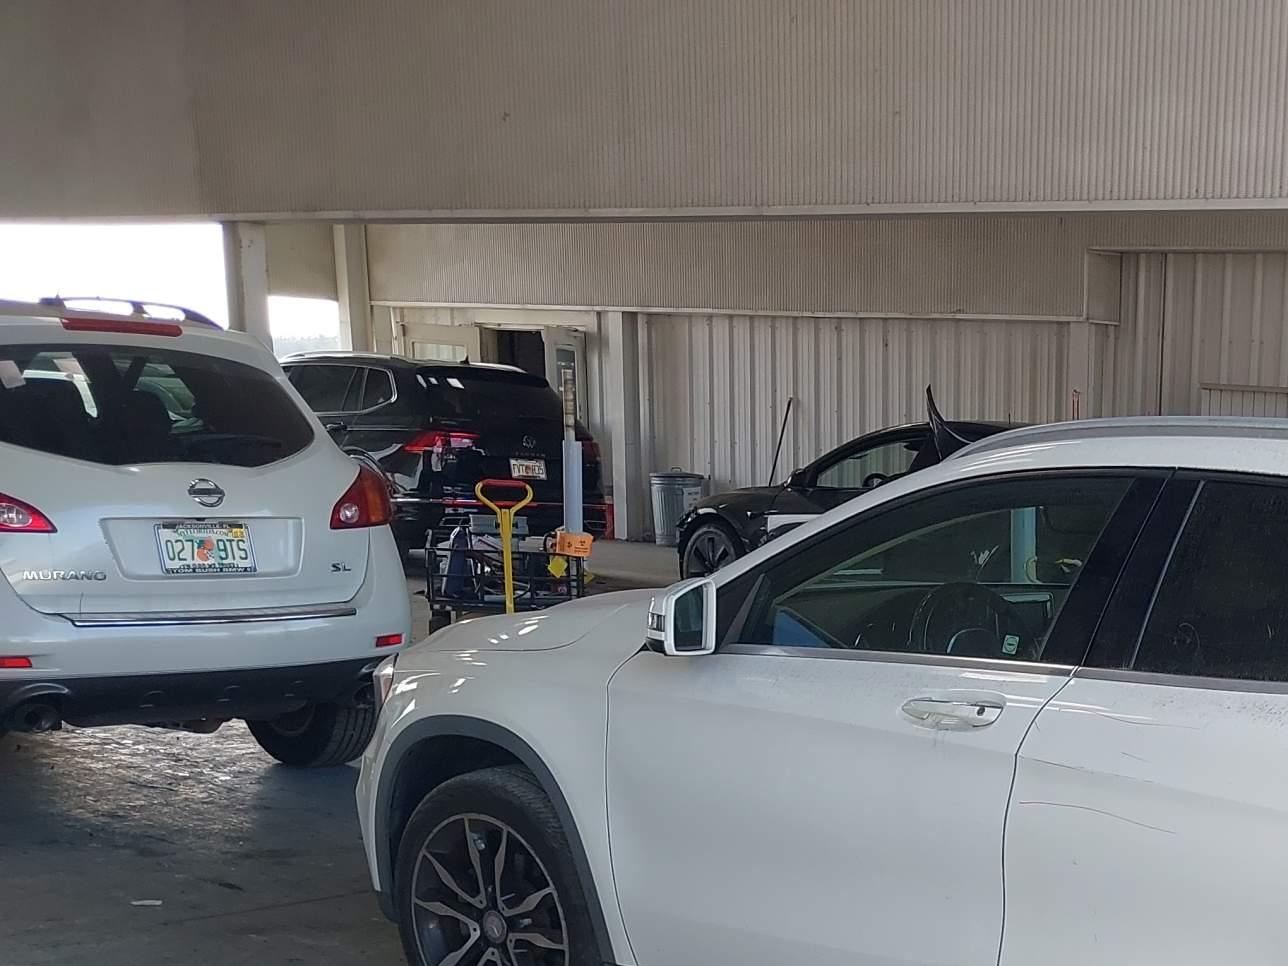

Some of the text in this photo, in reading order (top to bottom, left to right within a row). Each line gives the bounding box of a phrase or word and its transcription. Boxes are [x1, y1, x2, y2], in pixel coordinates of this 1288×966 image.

[165, 539, 249, 561] 027 9TS
[330, 561, 352, 573] SL
[23, 569, 107, 581] MURANO
